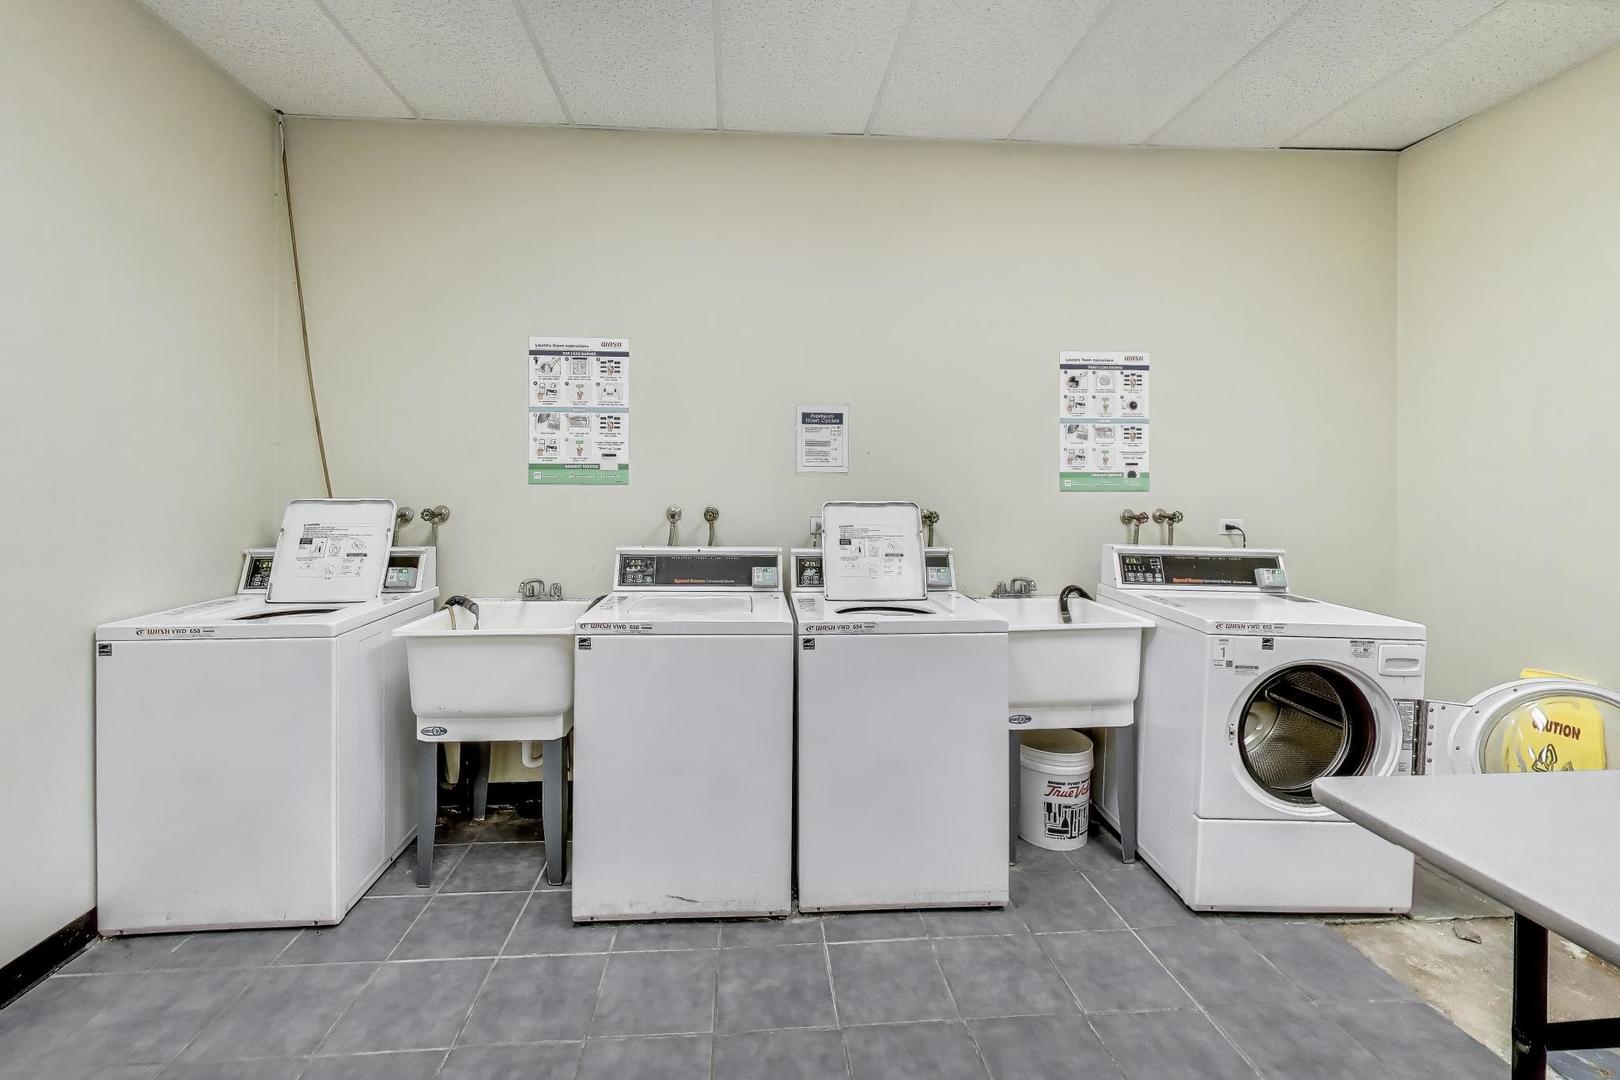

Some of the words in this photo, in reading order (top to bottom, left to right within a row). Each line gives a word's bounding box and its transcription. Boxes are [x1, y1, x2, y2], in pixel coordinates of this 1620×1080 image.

[1220, 646, 1226, 658] 1
[1532, 719, 1581, 740] UTION
[1044, 784, 1074, 798] True
